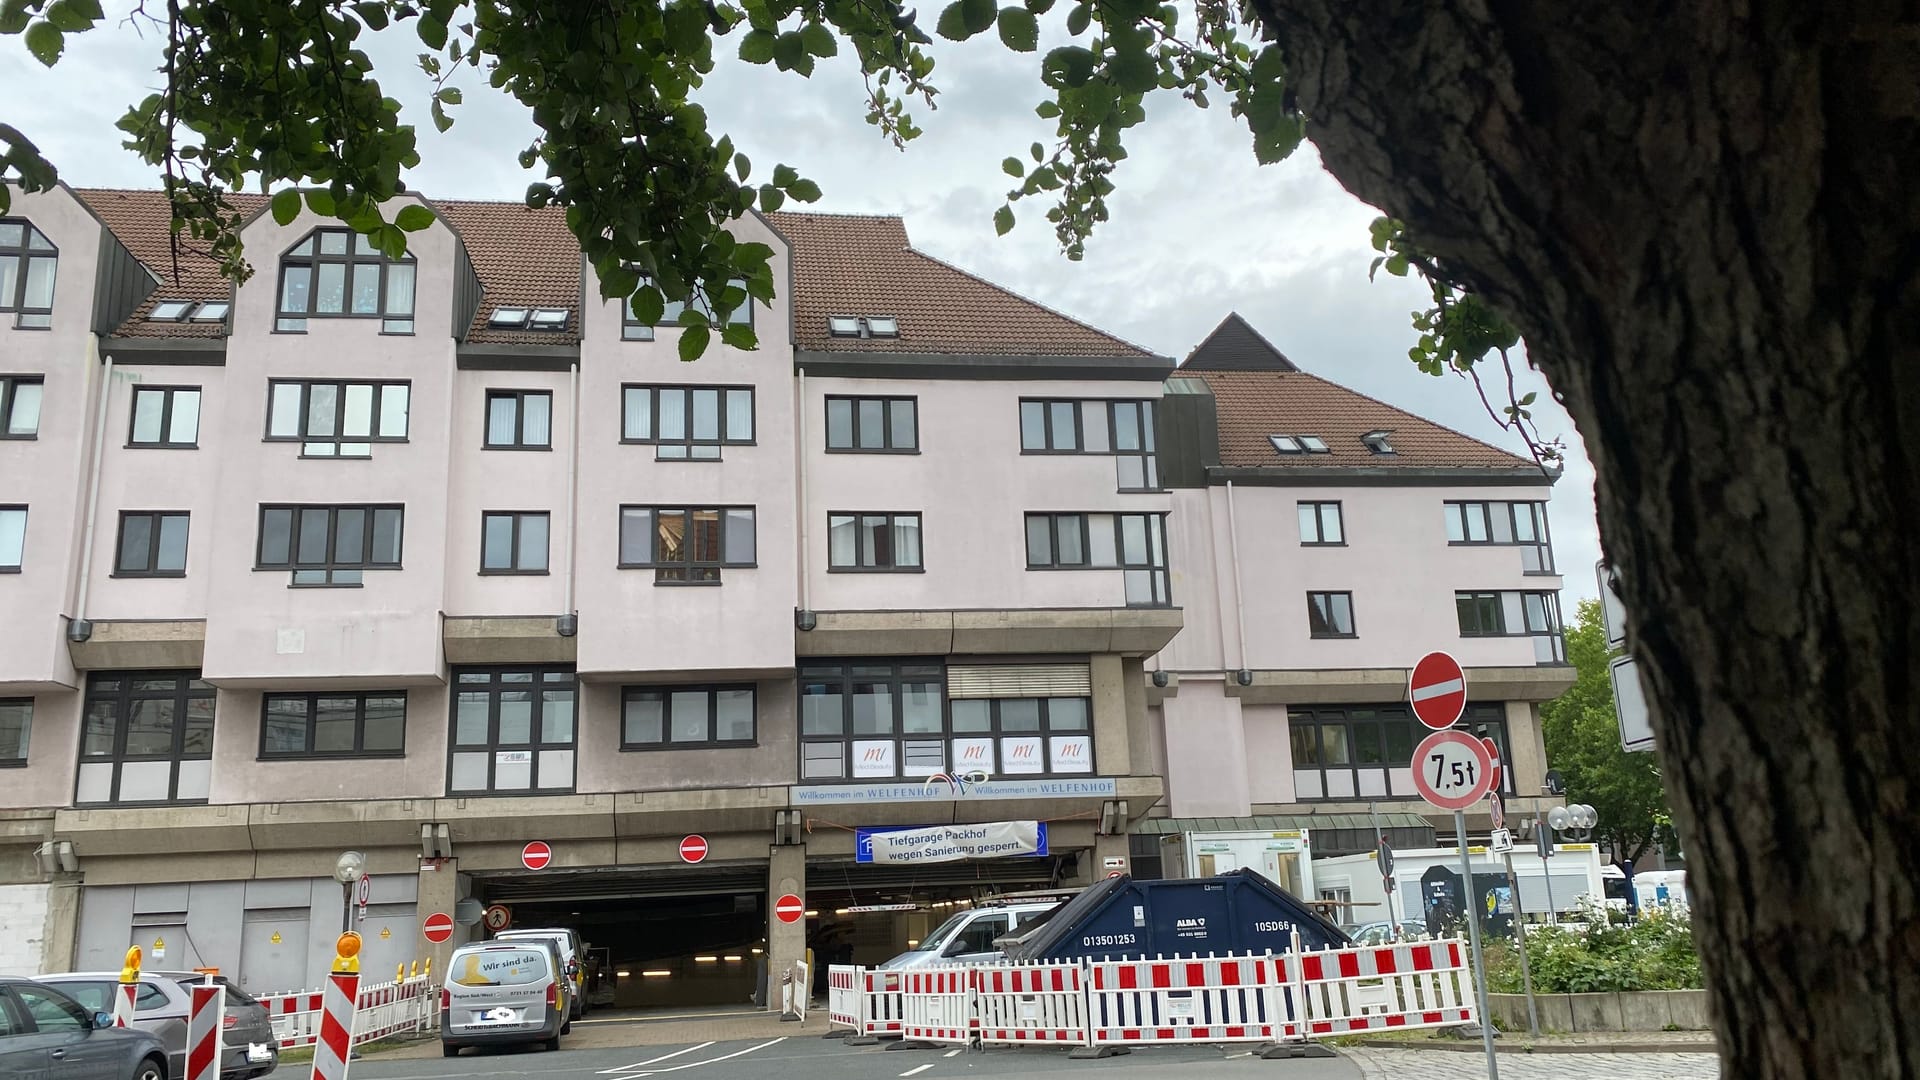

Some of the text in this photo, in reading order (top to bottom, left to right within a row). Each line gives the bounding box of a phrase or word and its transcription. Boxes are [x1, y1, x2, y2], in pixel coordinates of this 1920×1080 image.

[1431, 754, 1475, 789] 7,5t
[799, 787, 941, 800] Willkommen im WELFENHOF
[974, 782, 1114, 795] Willkommen im WELFENHOF
[888, 828, 987, 846] Tiefgarage Packhof
[888, 841, 1022, 861] wegen Sanierung gesperrt.
[1176, 918, 1198, 927] ALBA
[1254, 920, 1290, 932] 10SD66
[1083, 933, 1136, 947] 013501253
[483, 955, 537, 971] Wir sind da.
